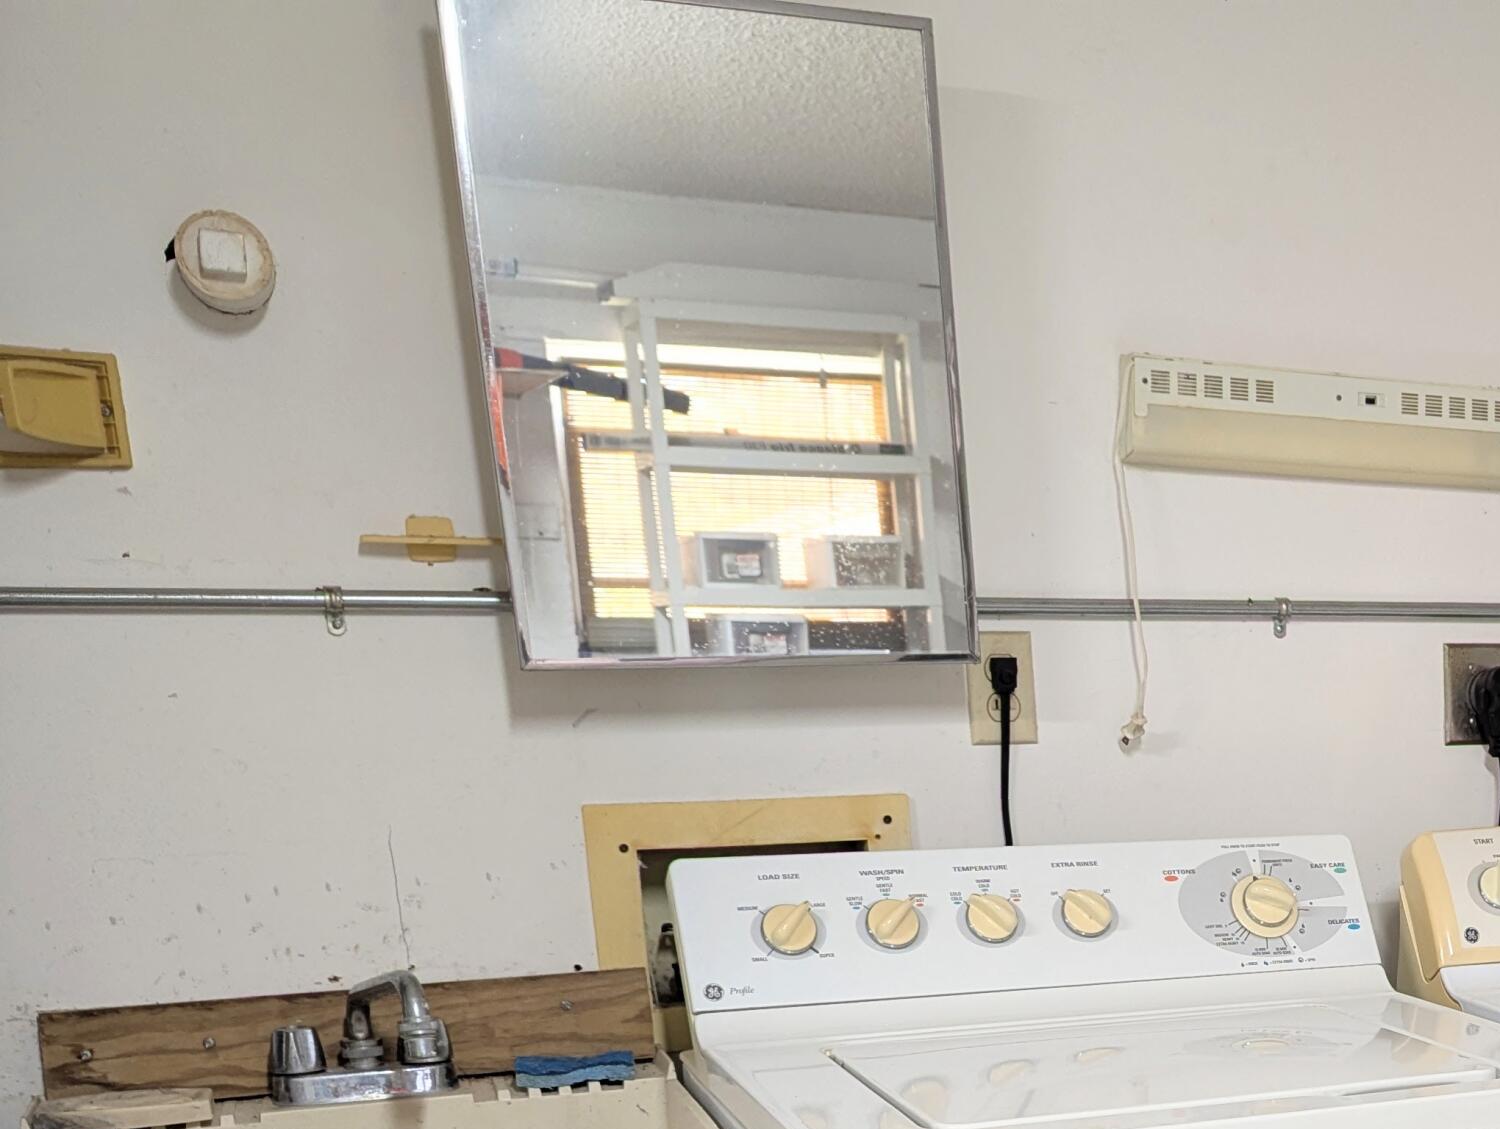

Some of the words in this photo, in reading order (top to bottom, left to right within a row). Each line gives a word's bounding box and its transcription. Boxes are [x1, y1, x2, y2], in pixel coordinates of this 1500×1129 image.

[1077, 860, 1099, 868] RINSE
[952, 864, 1009, 873] TEMPERATURE
[1162, 868, 1196, 876] COTTONS
[858, 869, 905, 877] WASH/SPIN
[1327, 917, 1361, 925] DELICATES
[729, 984, 755, 997] Profile
